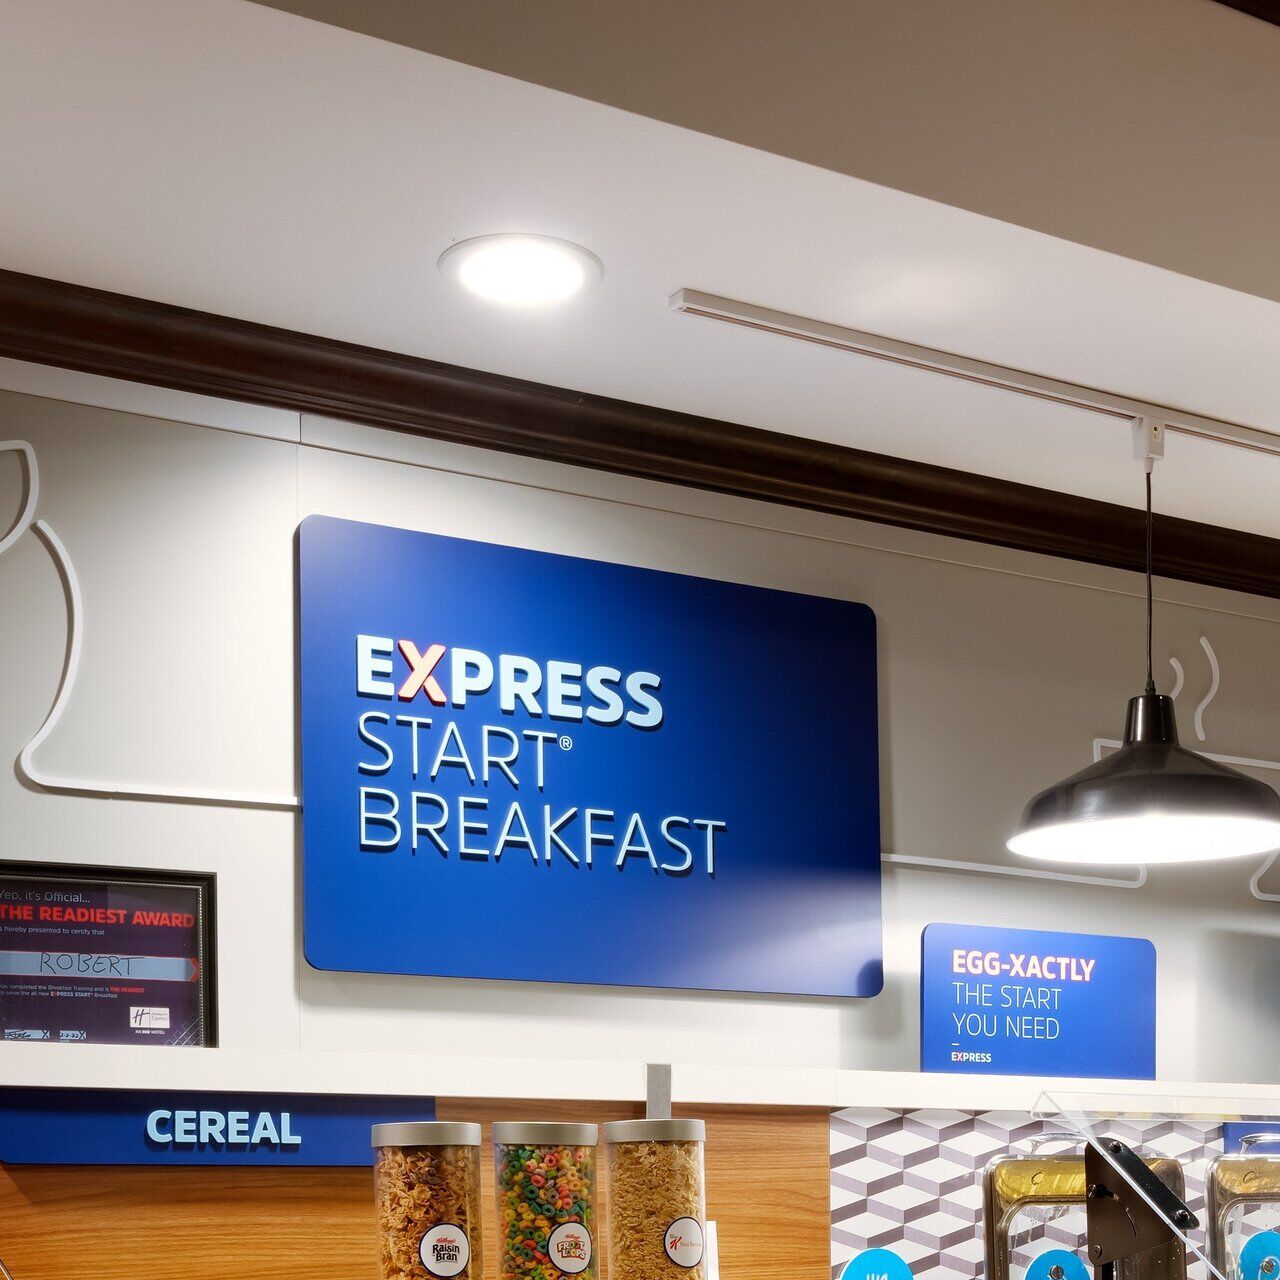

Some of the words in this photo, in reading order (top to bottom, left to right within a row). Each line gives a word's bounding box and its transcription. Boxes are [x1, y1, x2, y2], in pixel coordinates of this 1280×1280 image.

[355, 633, 664, 729] EXPRESS
[359, 786, 727, 876] BREAKFAST
[39, 906, 127, 925] READIEST
[132, 911, 196, 929] AWARD
[4, 925, 27, 934] hereby
[28, 927, 61, 935] presented
[70, 928, 91, 937] certify
[39, 951, 145, 976] ROBERT
[952, 949, 1096, 982] EGG-XACTLY
[952, 982, 993, 1006] THE
[1000, 985, 1062, 1010] START
[952, 1012, 997, 1036] YOU
[1006, 1015, 1060, 1040] NEED
[951, 1051, 992, 1063] EXPRESS
[145, 1109, 302, 1145] CEREAL
[432, 1244, 460, 1255] Raisin
[435, 1252, 459, 1262] Bran
